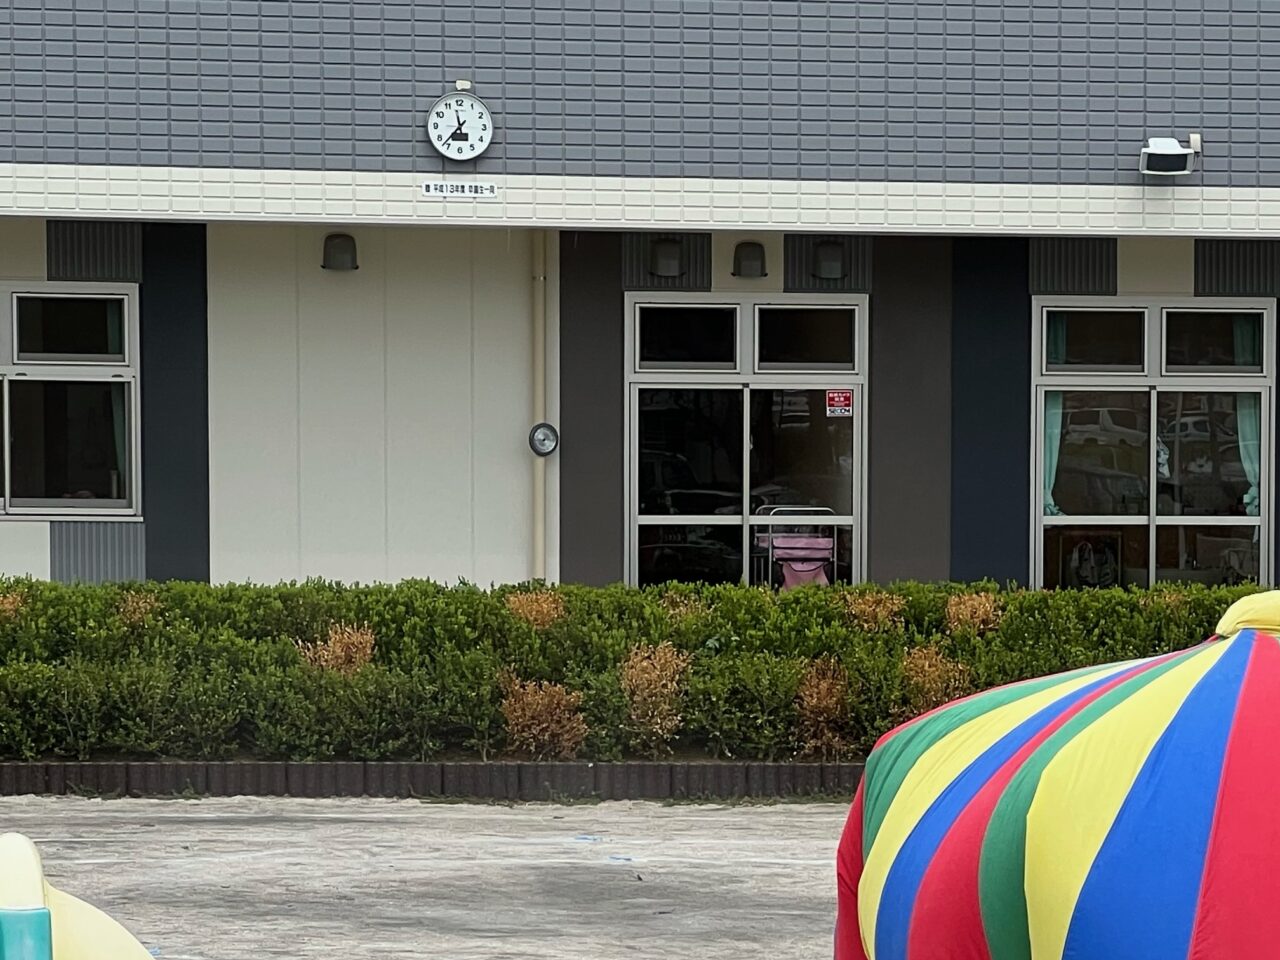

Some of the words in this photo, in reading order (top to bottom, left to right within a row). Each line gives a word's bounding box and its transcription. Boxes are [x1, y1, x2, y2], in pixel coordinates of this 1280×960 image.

[444, 102, 452, 110] 11
[455, 99, 464, 107] 12
[435, 111, 445, 119] 10
[433, 122, 439, 130] 9
[437, 134, 443, 142] 8
[457, 146, 463, 154] 6
